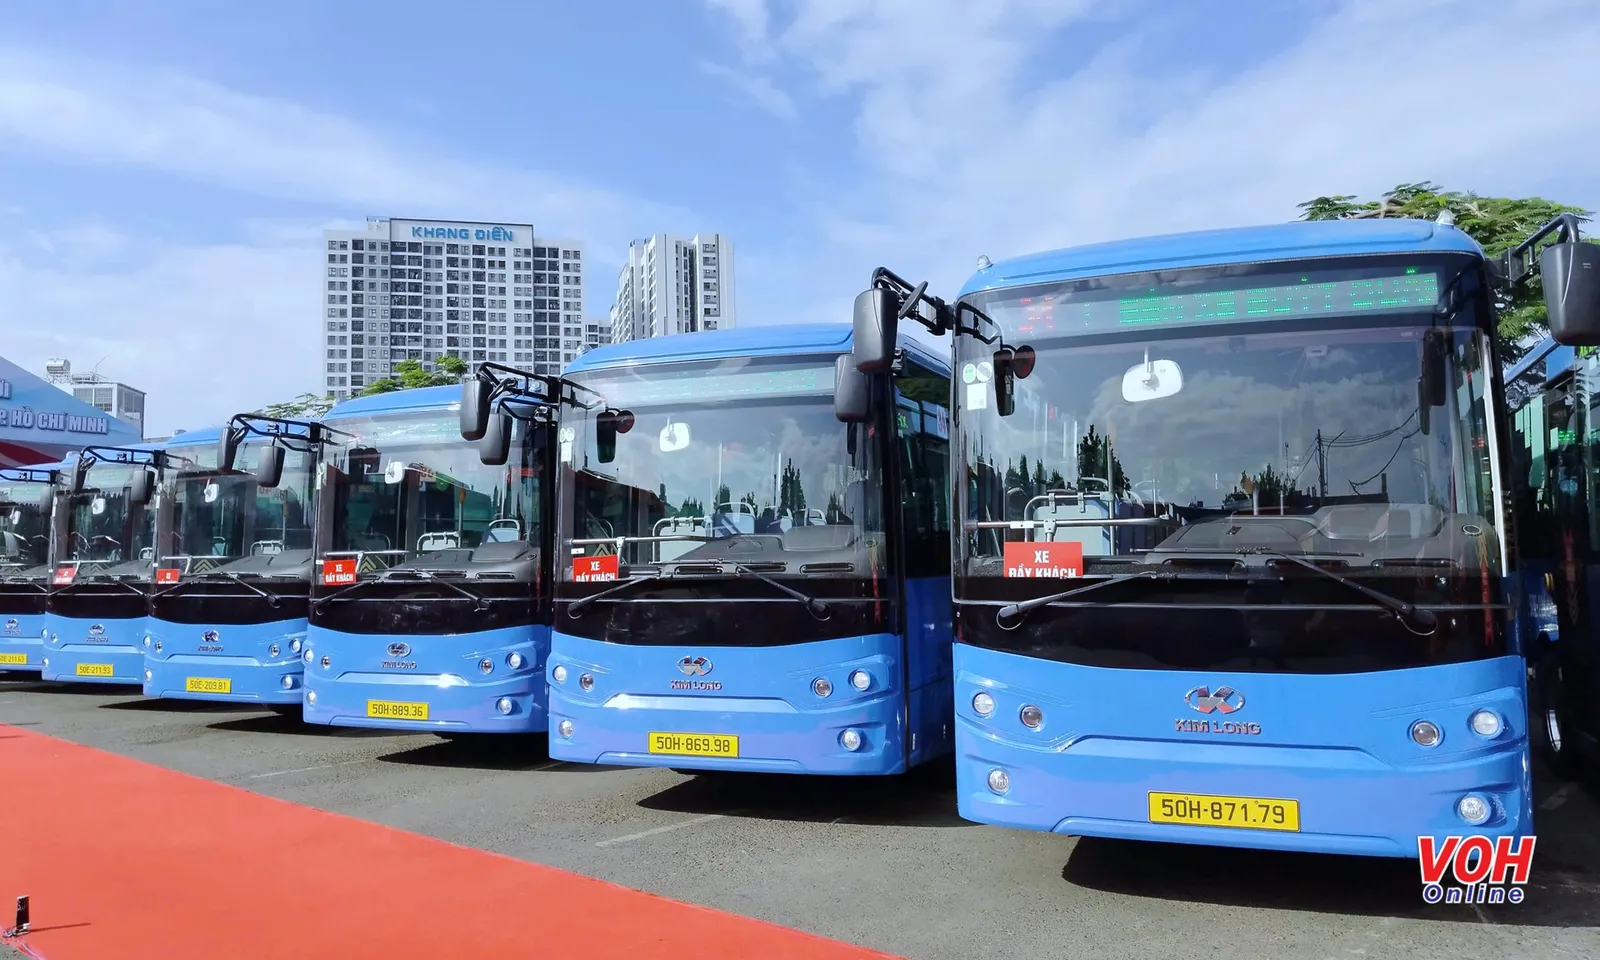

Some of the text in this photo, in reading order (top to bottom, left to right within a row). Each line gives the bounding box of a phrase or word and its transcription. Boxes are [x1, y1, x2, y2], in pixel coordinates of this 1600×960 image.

[411, 226, 469, 240] KHANG
[37, 411, 68, 431] CHÍ
[68, 415, 109, 435] MINH
[1034, 551, 1050, 563] XE
[590, 561, 601, 571] XE
[1035, 565, 1077, 579] KHÁCH
[189, 679, 227, 692] 50E-209.81
[670, 679, 723, 691] KIM LONG
[372, 703, 424, 717] 50H-889.36
[1174, 718, 1262, 736] KIM LONG
[656, 736, 731, 753] 50H-869.98
[1161, 798, 1286, 825] 50H-871.79
